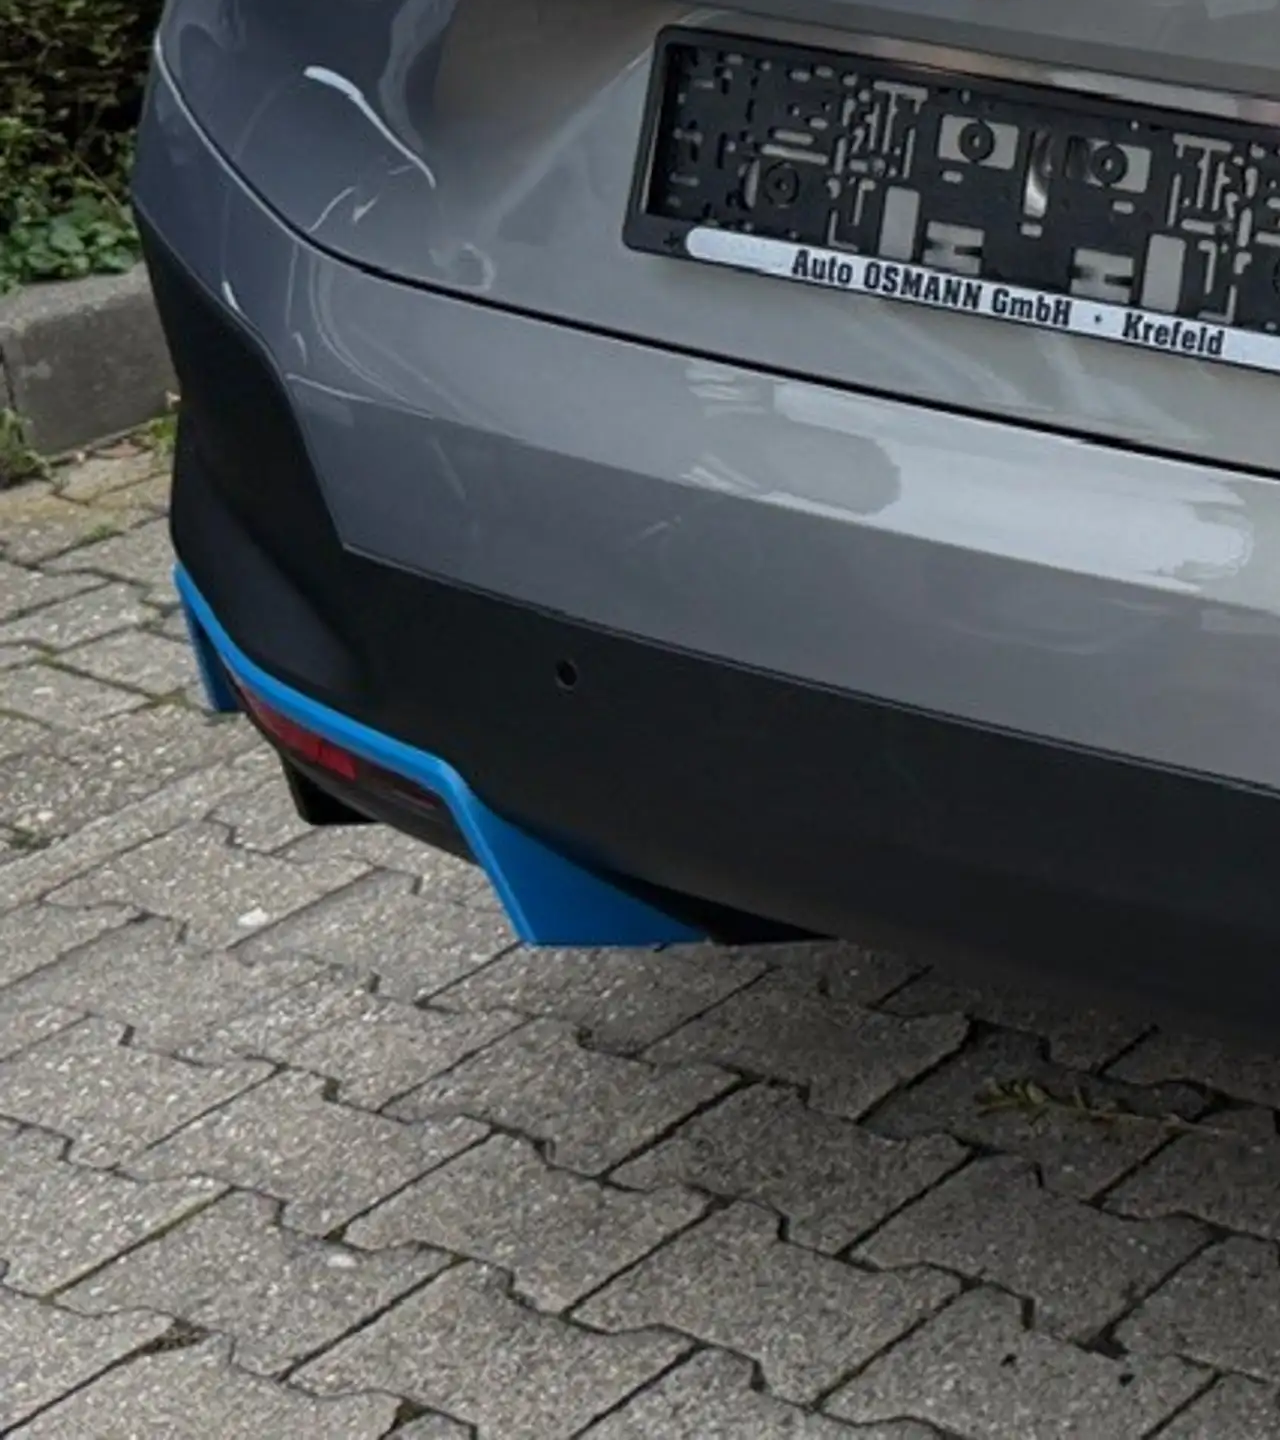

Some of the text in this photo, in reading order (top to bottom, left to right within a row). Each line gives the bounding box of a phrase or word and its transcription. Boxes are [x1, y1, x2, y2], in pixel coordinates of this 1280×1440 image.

[791, 248, 853, 285] Auto
[863, 261, 982, 311] OSMANN
[991, 287, 1073, 328] GmbH
[1121, 311, 1225, 356] Krefeld
